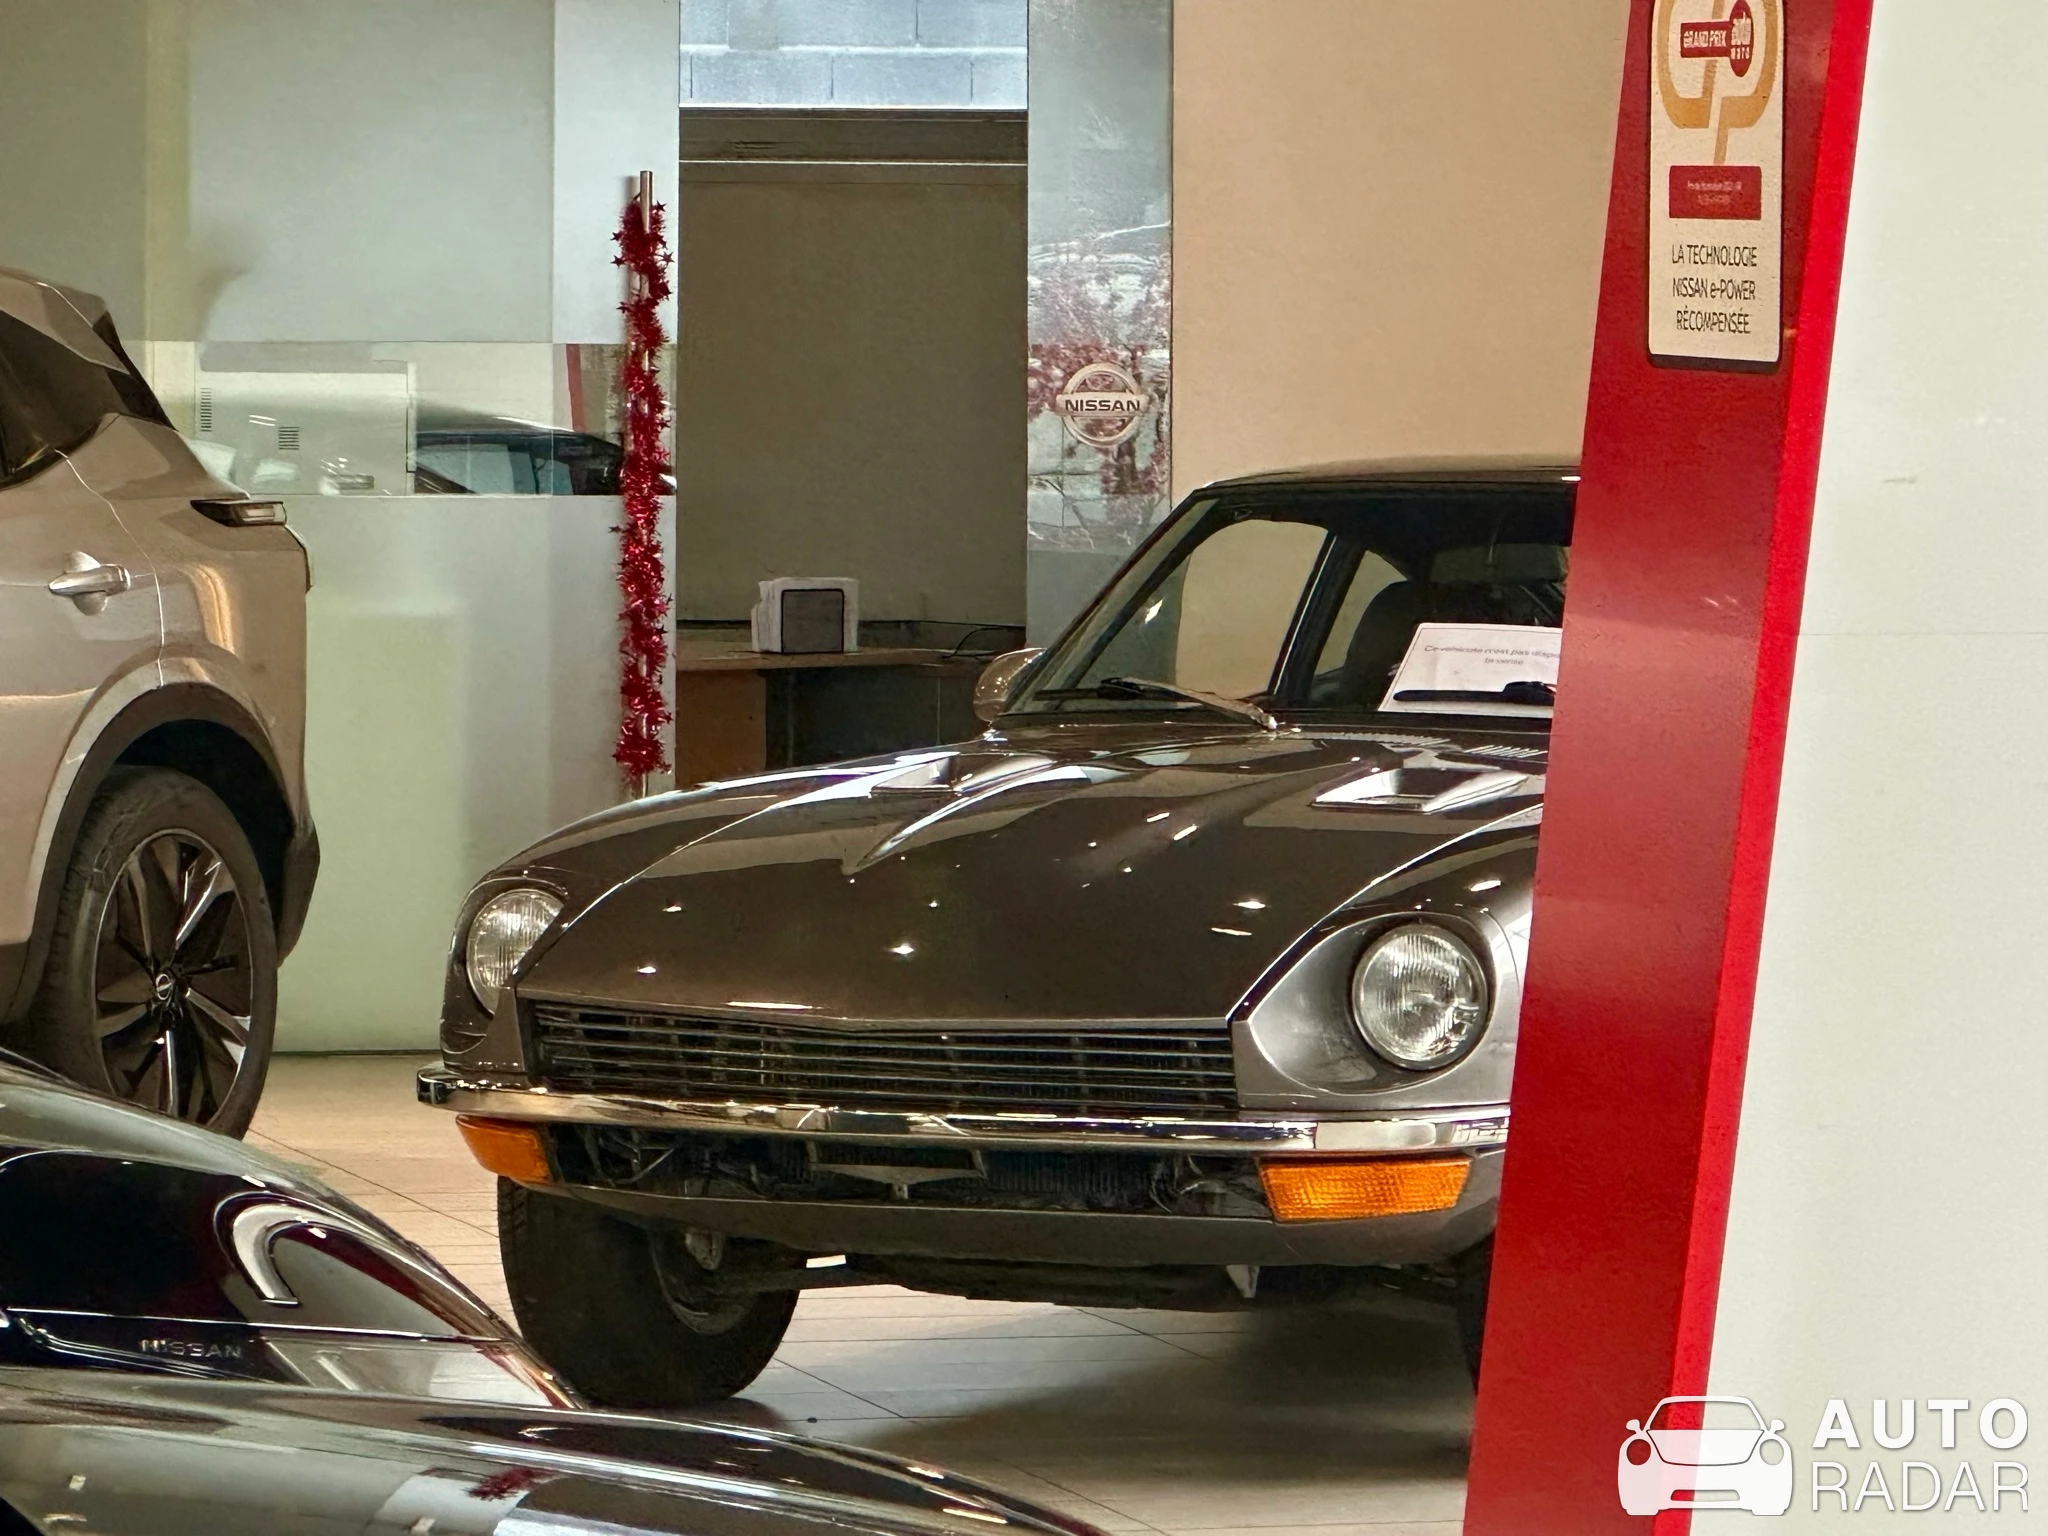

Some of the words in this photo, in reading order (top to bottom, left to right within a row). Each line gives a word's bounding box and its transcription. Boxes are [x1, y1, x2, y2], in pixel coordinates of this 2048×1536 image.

[1683, 30, 1709, 48] GRAND
[1709, 30, 1727, 47] PRIX
[1672, 244, 1685, 265] LA
[1687, 245, 1757, 267] TECHNOLOGIE
[1672, 277, 1708, 299] NISSAN
[1710, 280, 1756, 300] e-POWER
[1676, 306, 1752, 334] RÉCOMPENSÉE
[1065, 399, 1140, 412] NISSAN
[140, 1339, 244, 1359] NISSAN
